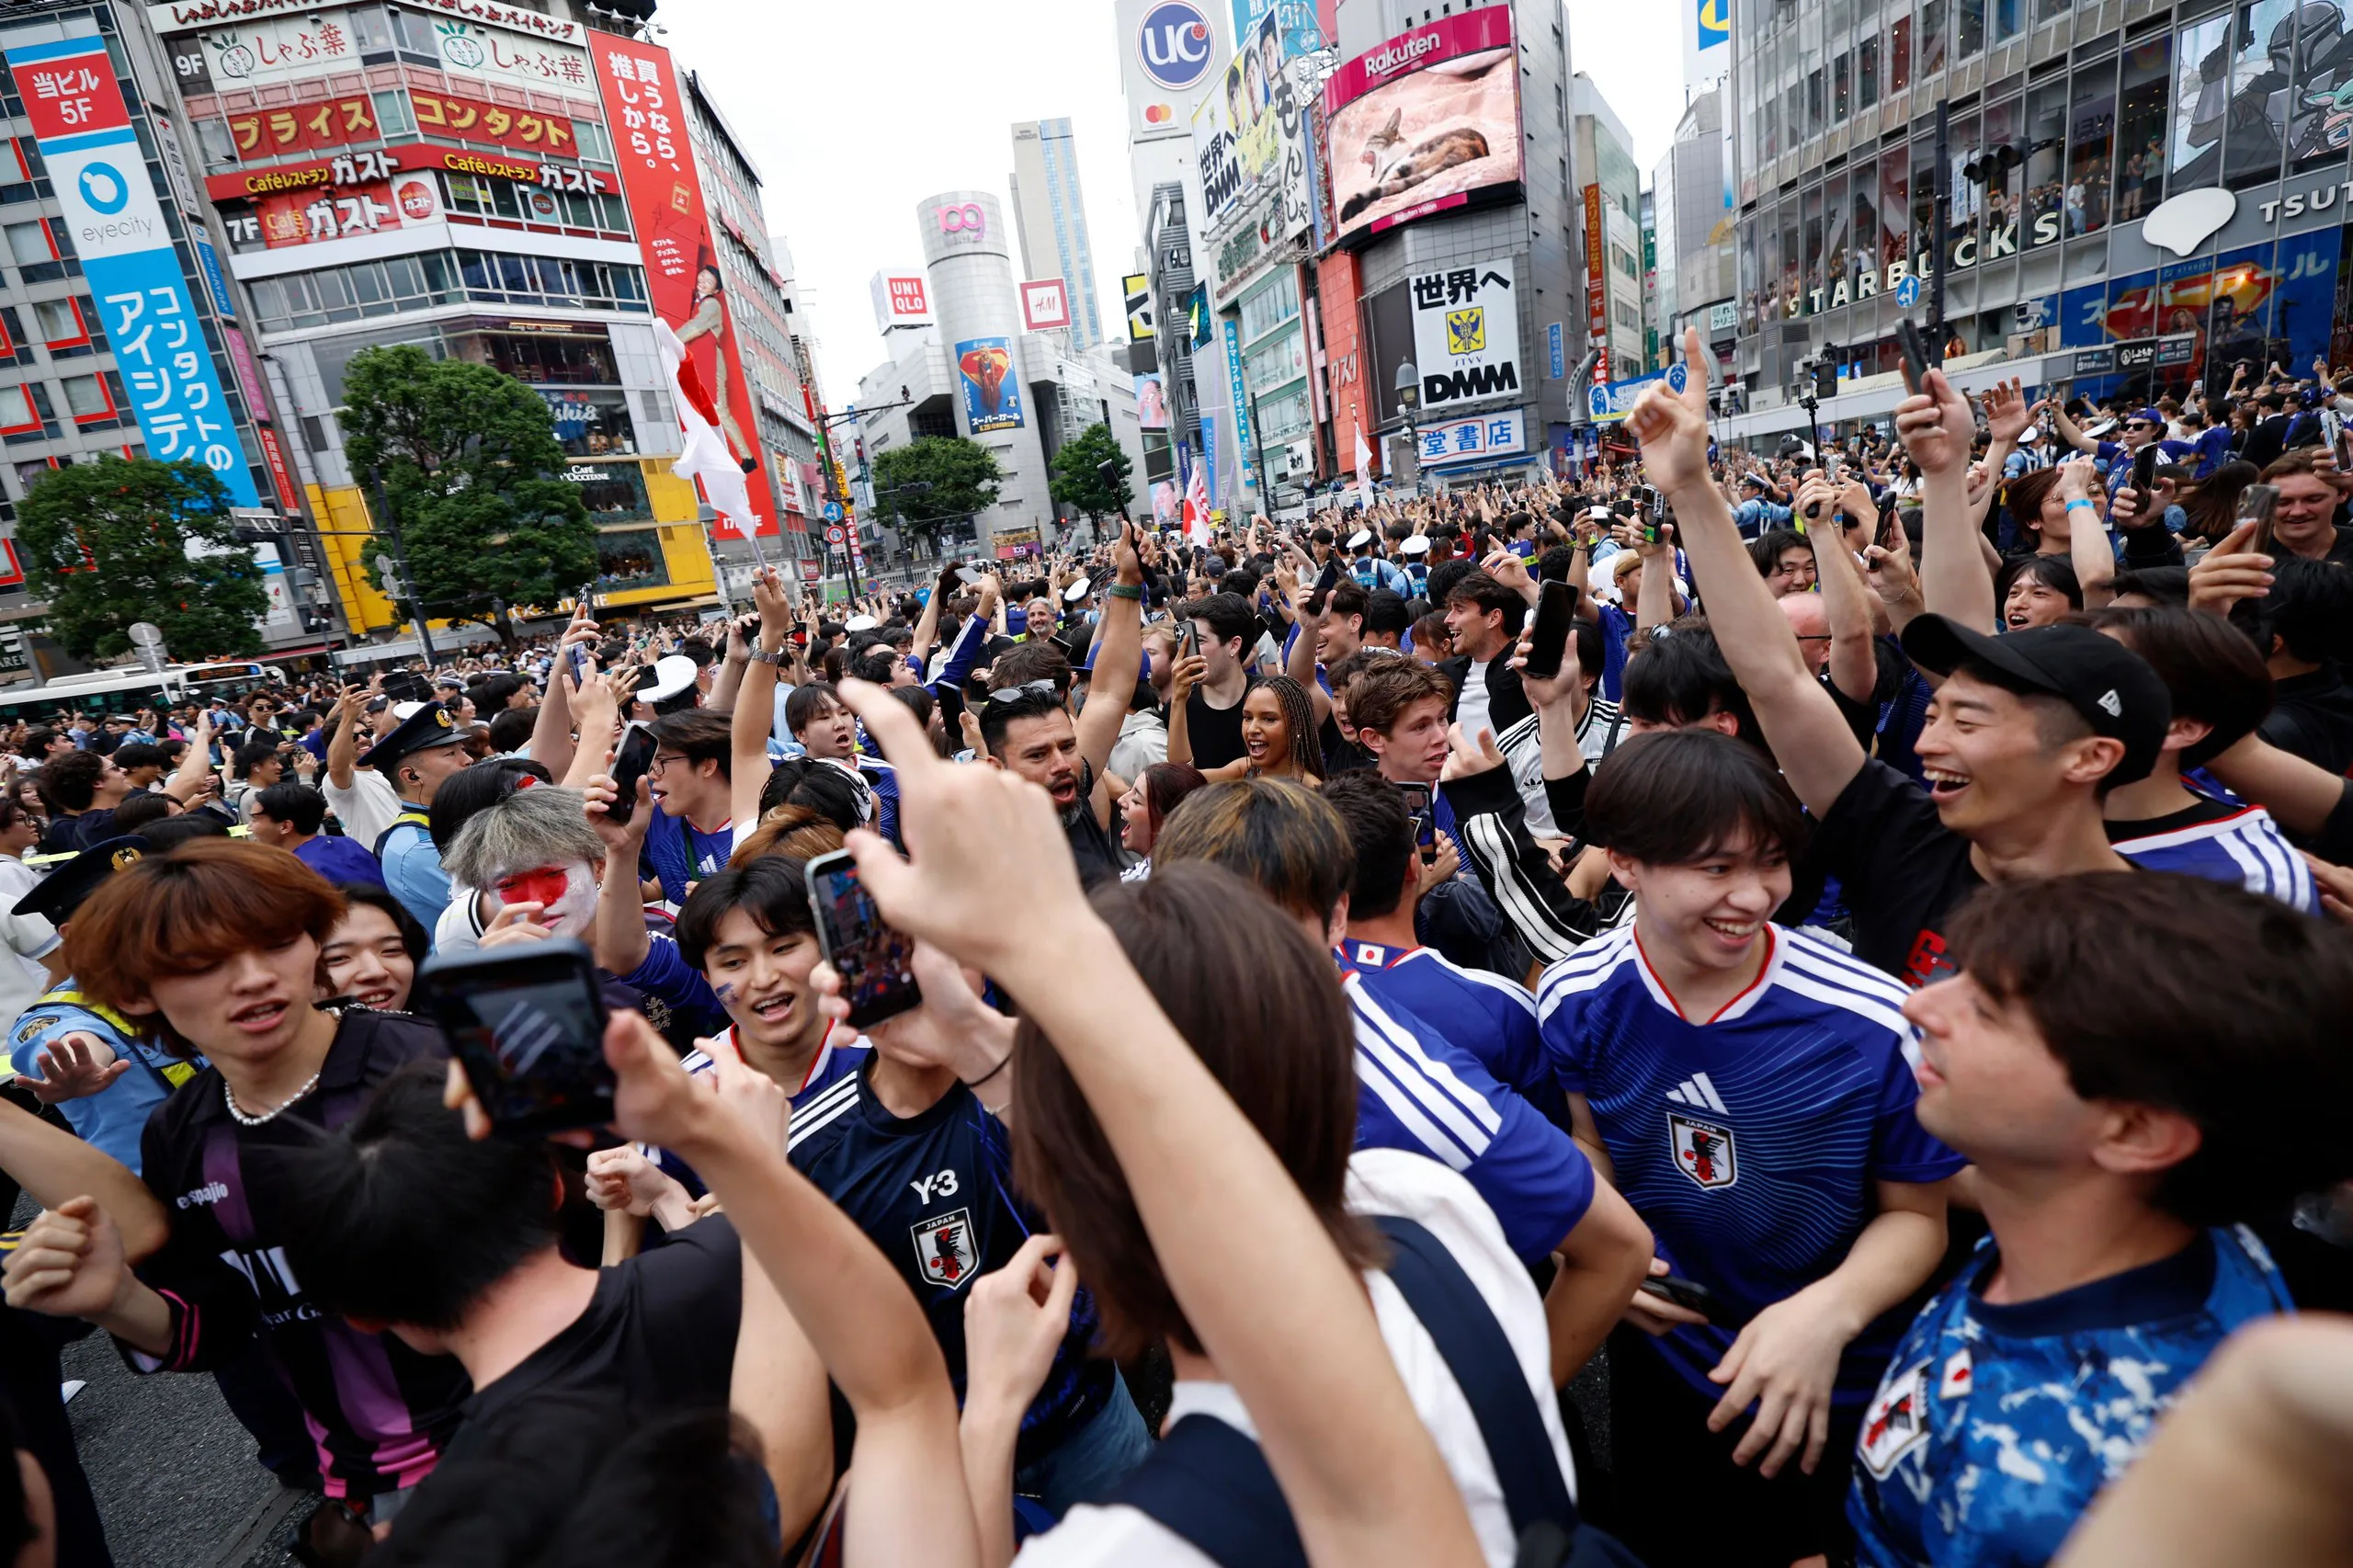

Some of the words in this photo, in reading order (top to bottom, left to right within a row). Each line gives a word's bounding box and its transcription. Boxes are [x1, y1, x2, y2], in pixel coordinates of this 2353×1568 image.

[176, 53, 204, 76] 9F
[256, 23, 347, 65] しゃぶ葉
[490, 39, 585, 85] しゃぶ葉
[1365, 32, 1440, 78] Rakuten
[31, 67, 99, 99] 当ビル
[59, 97, 92, 125] 5F
[233, 98, 374, 152] プライス
[411, 95, 571, 148] コンタクト
[608, 51, 656, 169] 推しから。
[634, 59, 681, 172] 買うなら、
[245, 168, 329, 193] Caféレストラン
[331, 150, 399, 185] ガスト
[444, 153, 536, 181] Caféレストラン
[539, 163, 606, 195] ガスト
[1199, 131, 1235, 186] 世界へ
[1204, 156, 1241, 218] DMM
[82, 215, 152, 244] eyecity
[225, 217, 259, 242] 7F
[306, 195, 391, 240] ガスト
[933, 203, 985, 241] 109
[1586, 187, 1600, 272] クスリのことなら
[892, 281, 918, 295] UNI
[896, 297, 923, 312] QLO
[1035, 296, 1056, 313] H&M
[1413, 267, 1510, 311] 世界へ
[2082, 251, 2329, 324] スーパーガール
[149, 286, 233, 472] コンタクトの
[1423, 361, 1518, 404] DMM
[1454, 355, 1483, 368] STVV
[1228, 340, 1246, 426] サマーフルーツギフト
[1424, 419, 1512, 456] 堂書店
[1012, 546, 1027, 556] 109
[1685, 1119, 1717, 1133] JAPAN
[909, 1169, 959, 1205] Y-3
[926, 1214, 955, 1231] JAPAN
